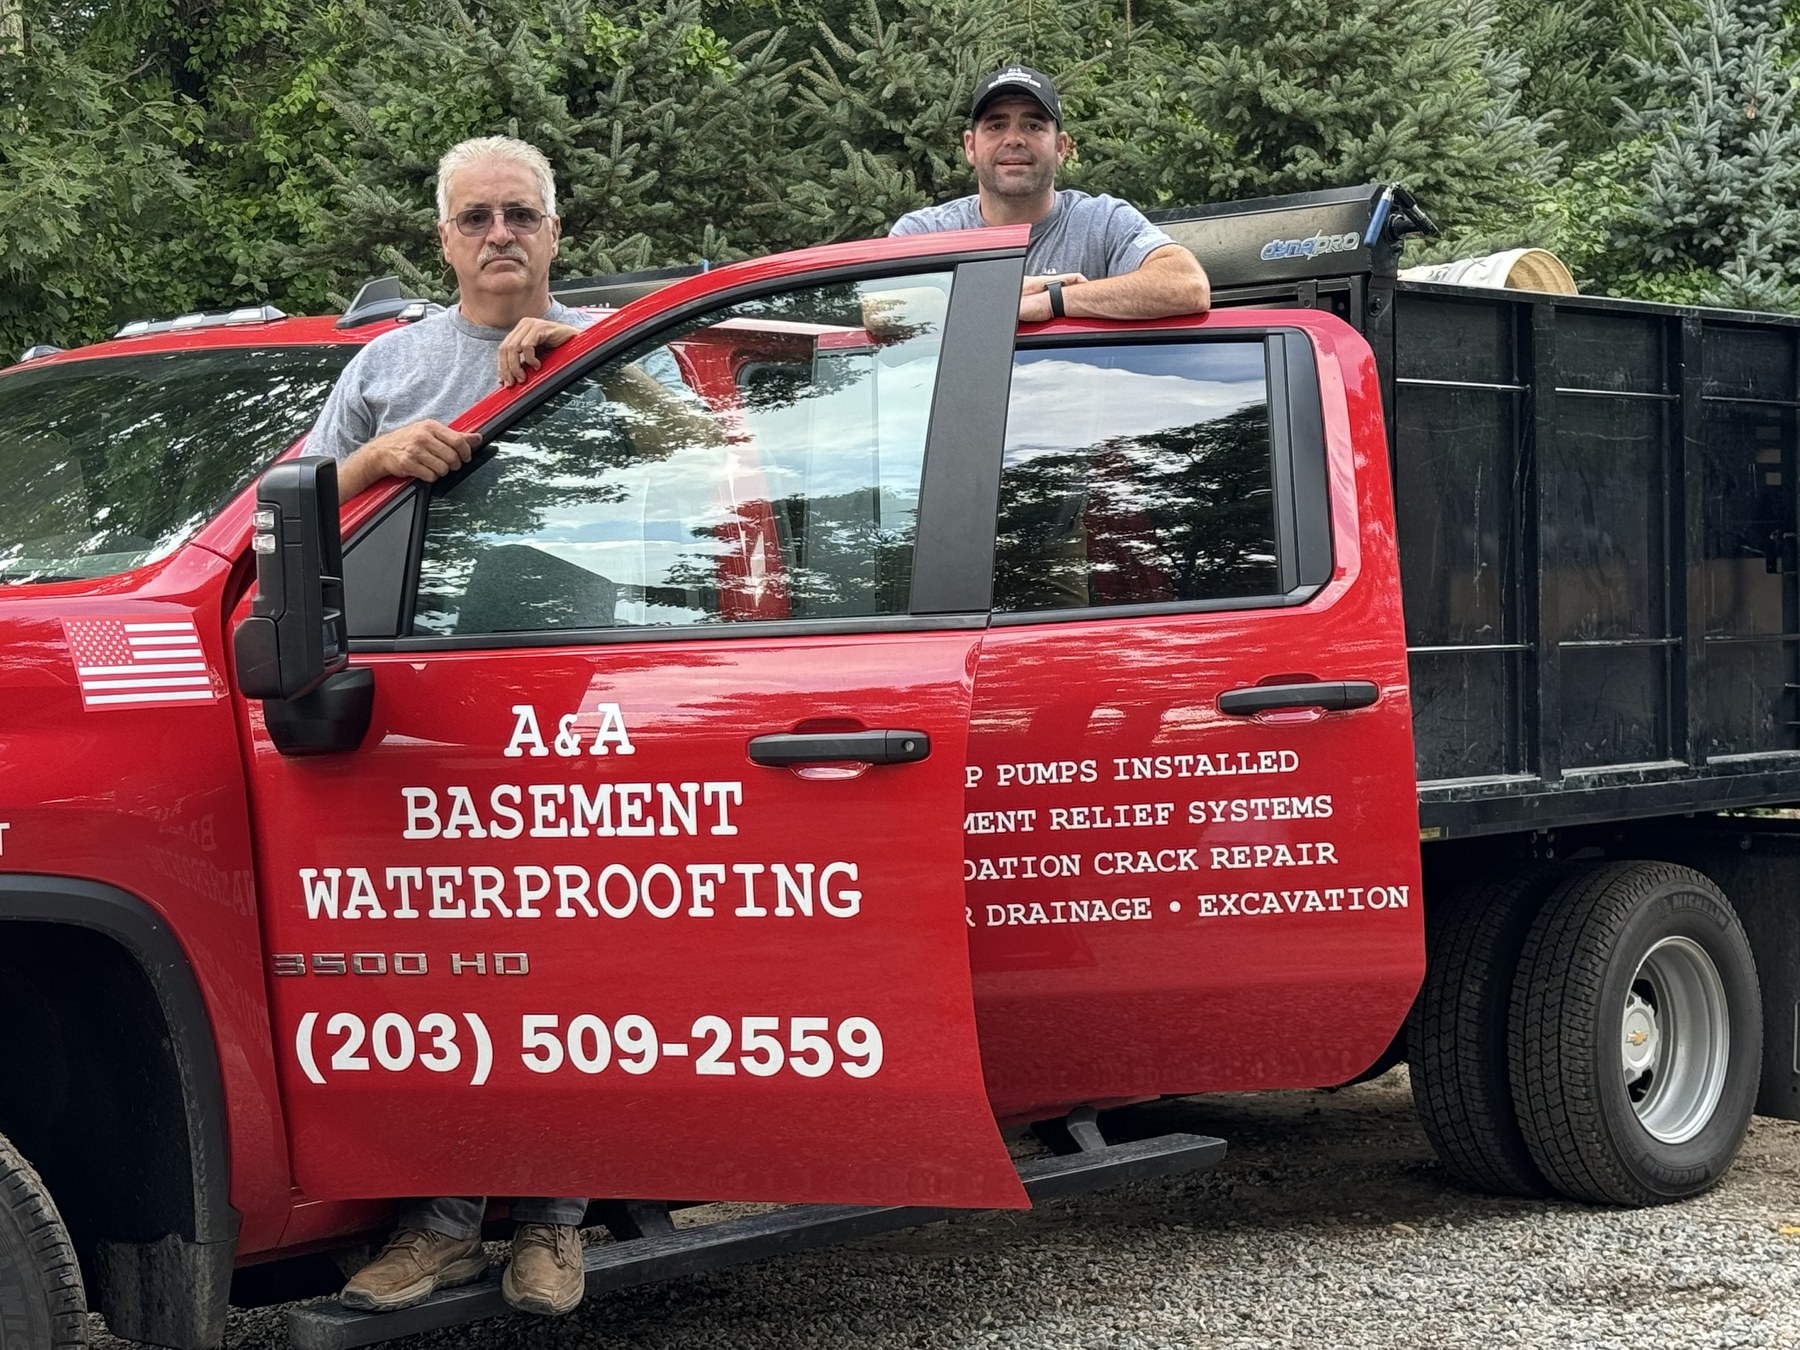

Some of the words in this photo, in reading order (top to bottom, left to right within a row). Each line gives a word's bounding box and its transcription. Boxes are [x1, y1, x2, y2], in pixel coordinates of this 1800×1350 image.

[503, 702, 636, 758] A&A
[996, 759, 1098, 786] PUMPS
[1112, 750, 1299, 781] INSTALLED
[401, 781, 743, 840] BASEMENT
[1048, 802, 1175, 830] RELIEF
[1188, 794, 1333, 824] SYSTEMS
[1093, 848, 1199, 875] CRACK
[1209, 842, 1339, 870] REPAIR
[298, 861, 863, 920] WATERPROOFING
[986, 897, 1152, 927] DRAINAGE
[1197, 885, 1410, 917] EXCAVATION
[272, 952, 429, 976] 3500
[450, 952, 531, 976] HD
[295, 1012, 493, 1086] (203)
[521, 1014, 884, 1079] 509-2559
